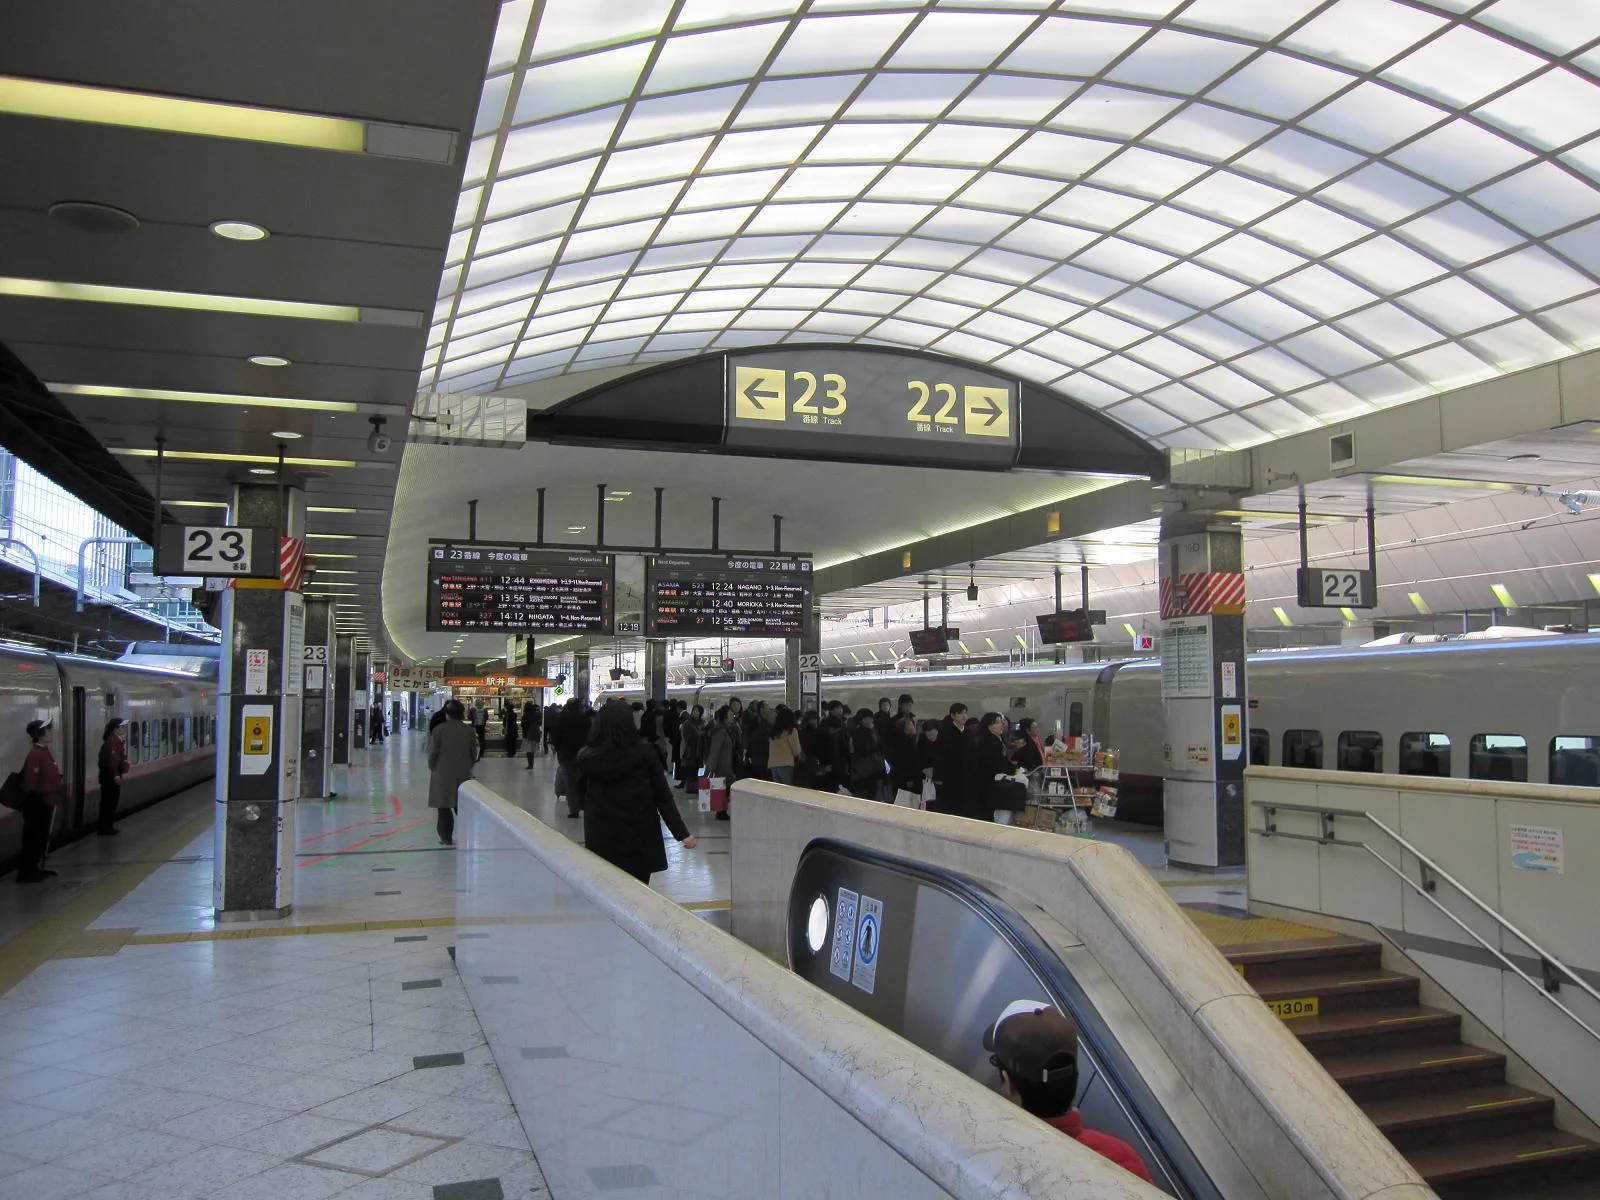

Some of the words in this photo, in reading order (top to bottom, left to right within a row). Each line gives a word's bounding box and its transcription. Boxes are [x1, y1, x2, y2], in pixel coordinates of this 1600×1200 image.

[793, 371, 847, 416] 23
[906, 380, 959, 424] 22
[825, 416, 842, 425] Track
[188, 530, 245, 562] 23
[450, 550, 481, 560] 23番線
[769, 561, 797, 571] 22番線
[500, 575, 526, 585] 12:44
[711, 581, 734, 591] 12:24
[737, 583, 763, 591] NAGANO
[1324, 574, 1359, 598] 22
[500, 593, 525, 603] 13:56
[711, 599, 735, 608] 12:40
[500, 610, 525, 621] 14:12
[528, 613, 555, 621] NIIGATA
[711, 616, 735, 625] 12:56
[618, 622, 640, 632] 12:18
[303, 647, 327, 660] 23
[697, 656, 710, 667] 22
[799, 655, 820, 669] 22
[1267, 1001, 1314, 1016] 130m
